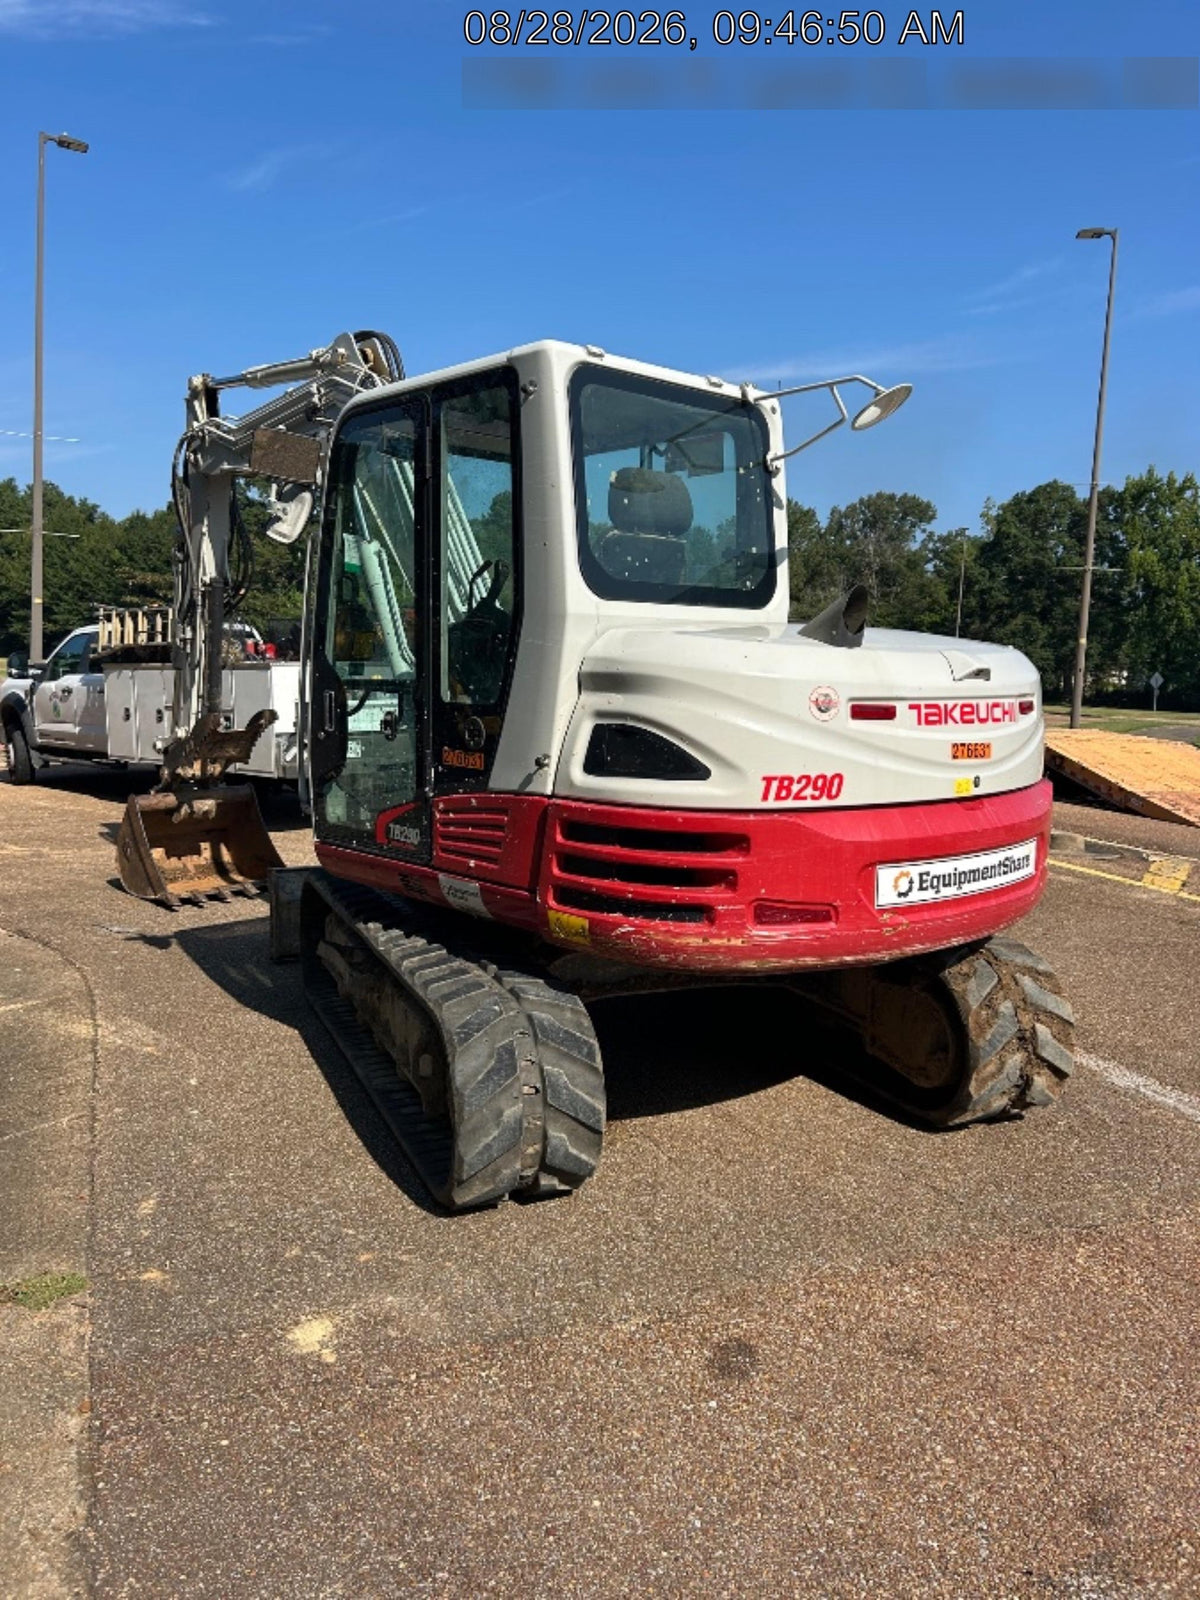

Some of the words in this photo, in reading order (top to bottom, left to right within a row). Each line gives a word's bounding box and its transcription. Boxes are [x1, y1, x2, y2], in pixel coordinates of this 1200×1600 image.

[908, 702, 1017, 726] TAKEUCHI
[761, 773, 844, 802] TB290
[917, 853, 1031, 894] EquipmentShare
